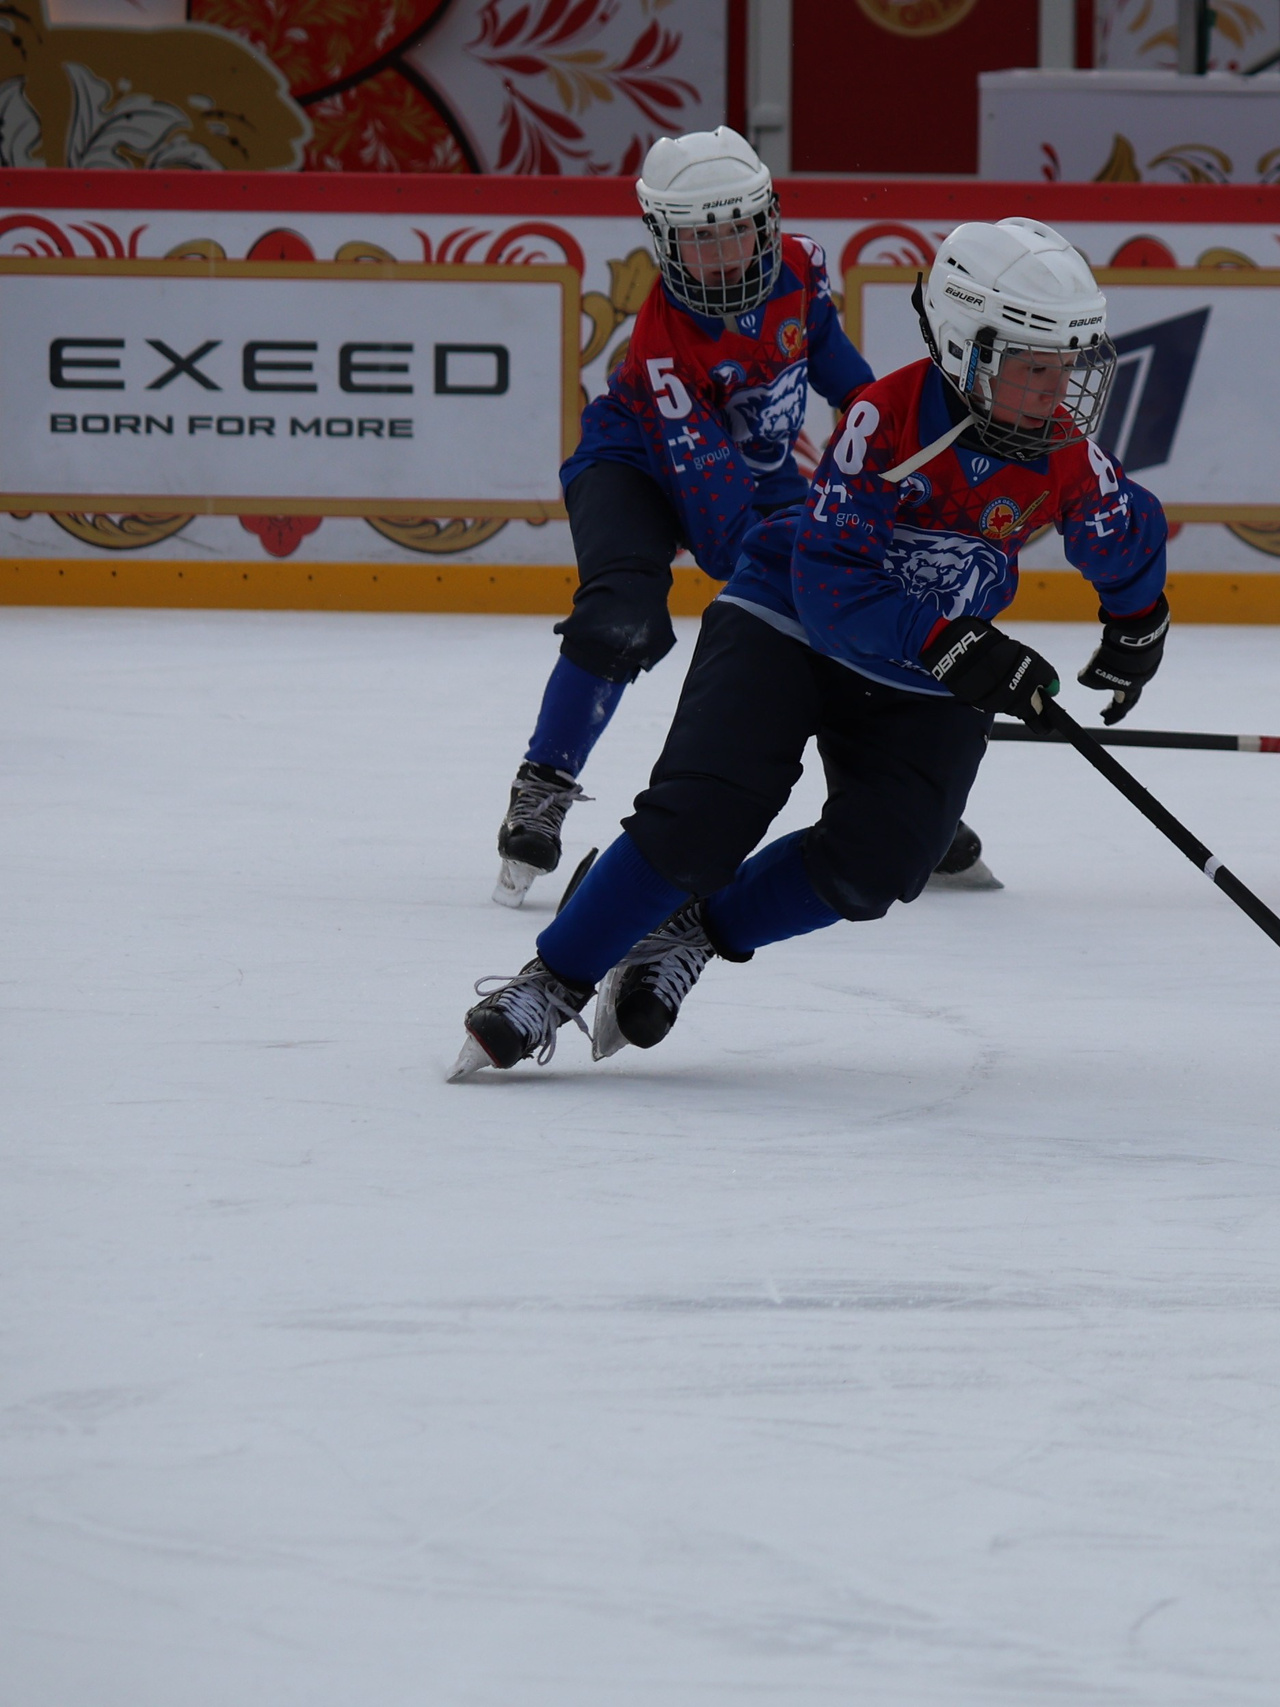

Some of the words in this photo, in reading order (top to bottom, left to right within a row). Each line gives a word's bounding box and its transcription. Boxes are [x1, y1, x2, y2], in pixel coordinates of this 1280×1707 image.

[945, 287, 983, 306] BAUER
[1068, 315, 1103, 328] BAUER
[49, 336, 510, 396] EXEED
[646, 357, 693, 419] 5
[50, 413, 173, 435] BORN
[188, 415, 275, 436] FOR
[290, 417, 413, 438] MORE
[833, 400, 880, 475] 8
[693, 446, 731, 470] group
[1086, 438, 1119, 496] 8
[931, 630, 988, 681] OBRA
[1009, 655, 1032, 691] CARBON
[1095, 668, 1132, 686] CARBON
